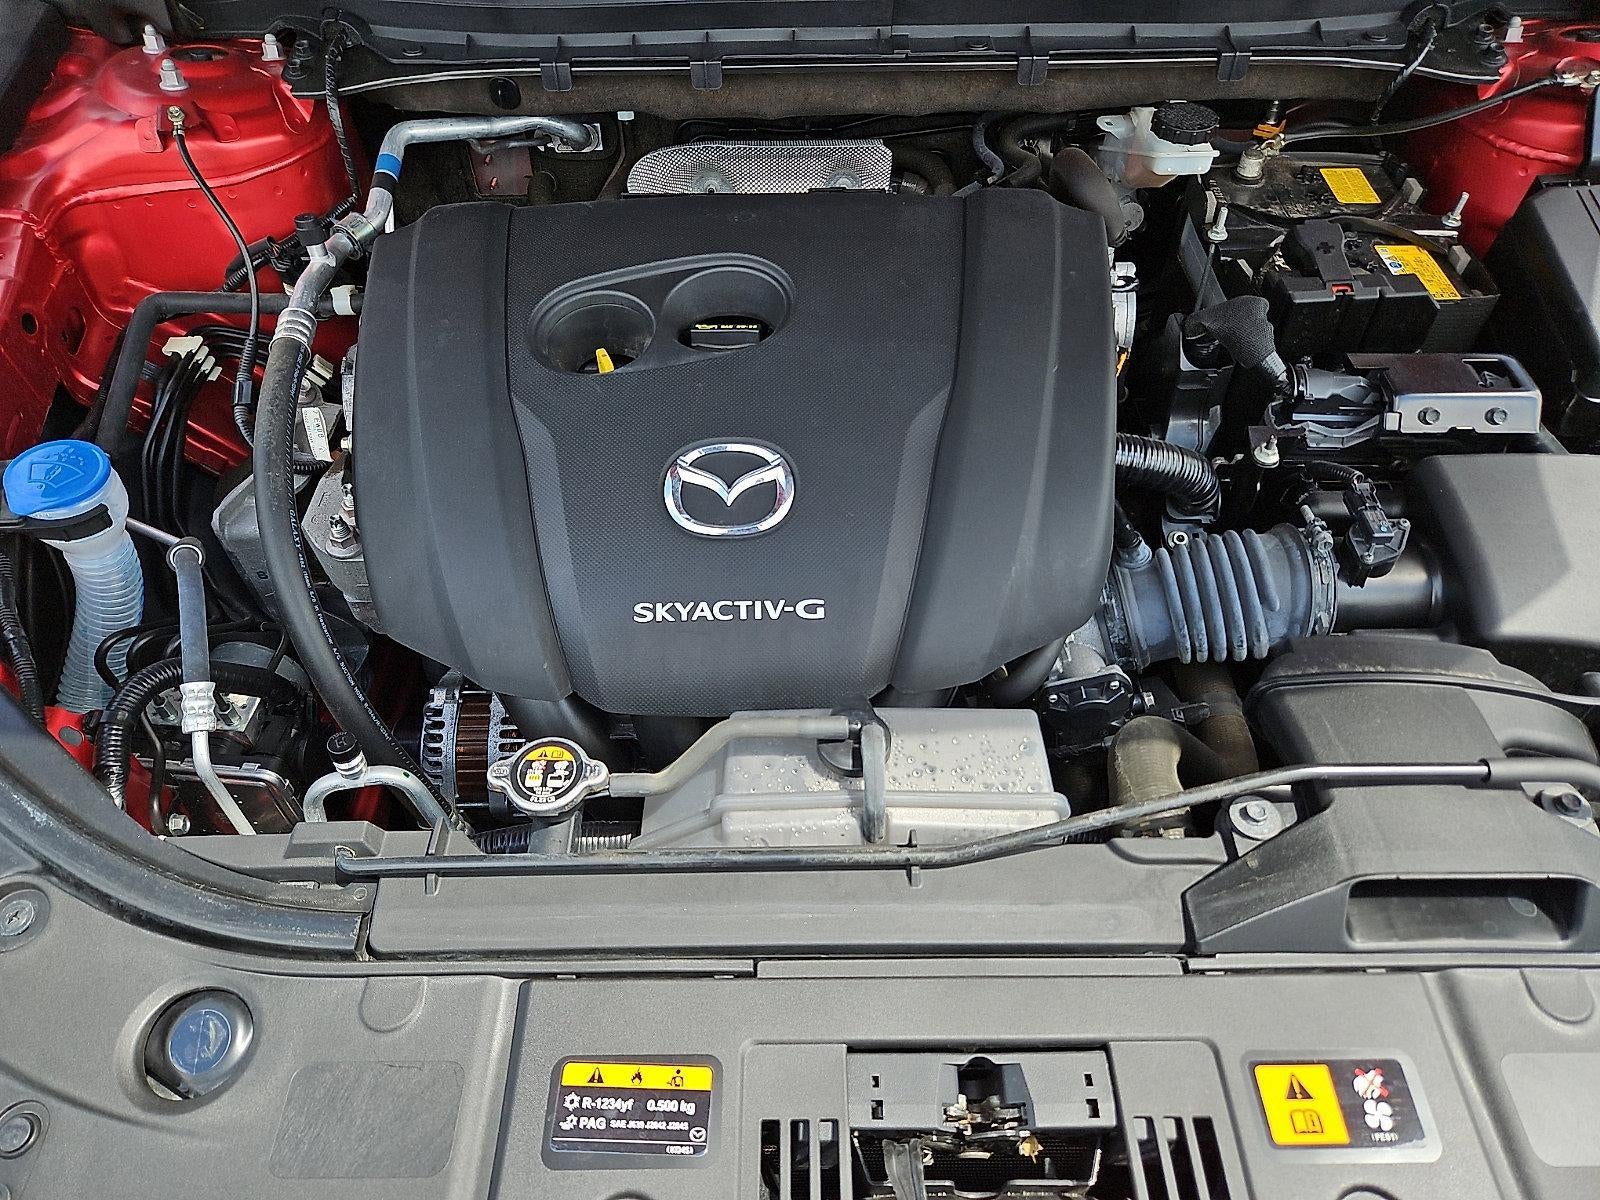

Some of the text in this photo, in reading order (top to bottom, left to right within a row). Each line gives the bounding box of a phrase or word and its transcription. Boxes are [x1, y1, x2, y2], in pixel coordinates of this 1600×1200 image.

[289, 509, 302, 550] GALAXY
[332, 647, 341, 660] A/C
[340, 661, 356, 686] SUCTION
[633, 599, 826, 623] SKYACTIV-G
[581, 1097, 696, 1115] R-1234yf 0.500 kg
[579, 1117, 607, 1130] PAG
[609, 1119, 627, 1129] SAE
